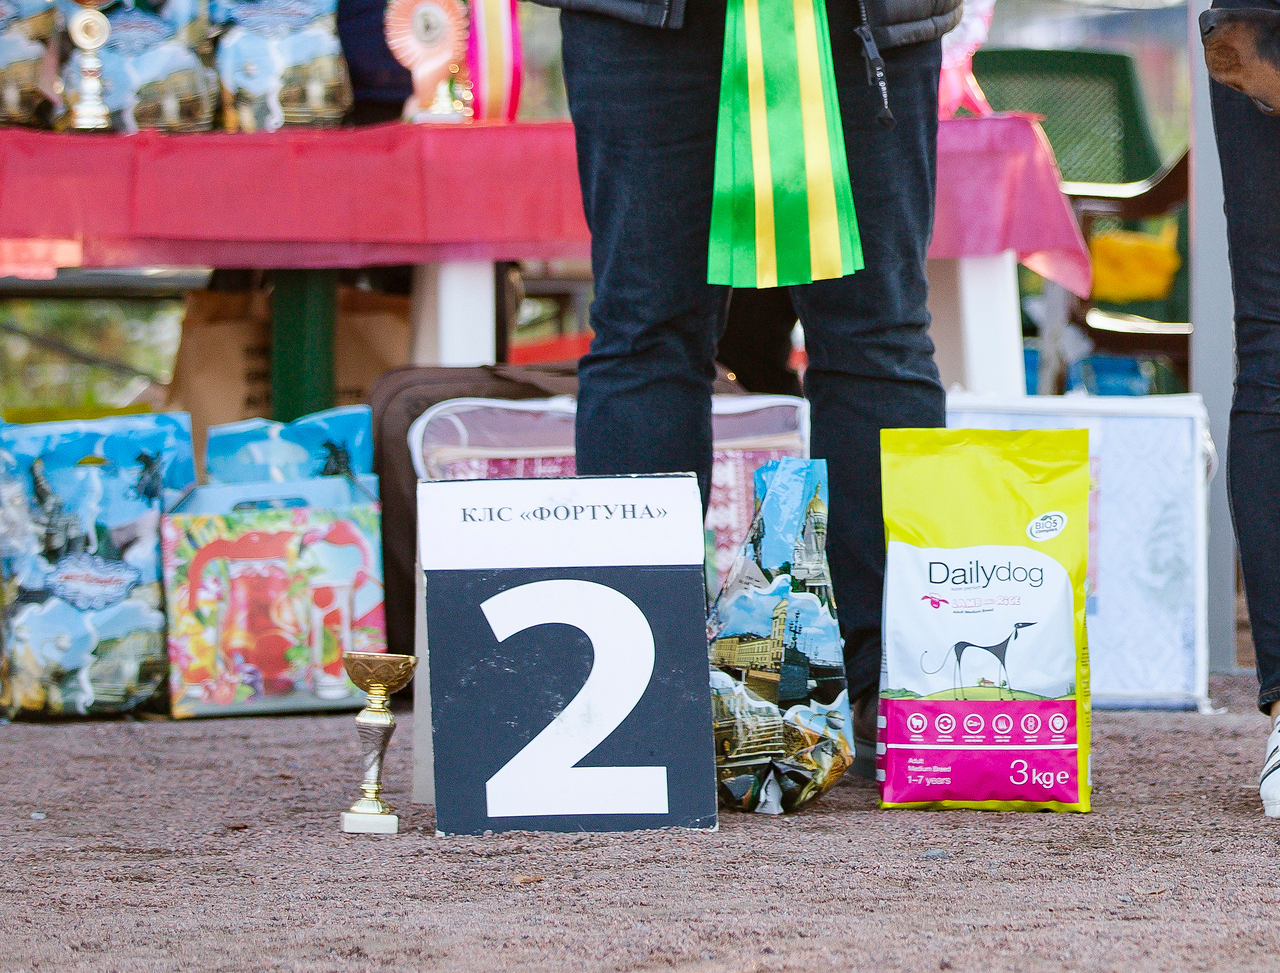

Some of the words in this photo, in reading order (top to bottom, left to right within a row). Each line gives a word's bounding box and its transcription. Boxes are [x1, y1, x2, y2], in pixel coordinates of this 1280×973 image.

[461, 507, 513, 522] КЛС
[520, 504, 668, 521] «ФОРТУНА»
[928, 560, 1044, 588] Dailydog
[479, 579, 668, 817] 2
[924, 778, 952, 787] years
